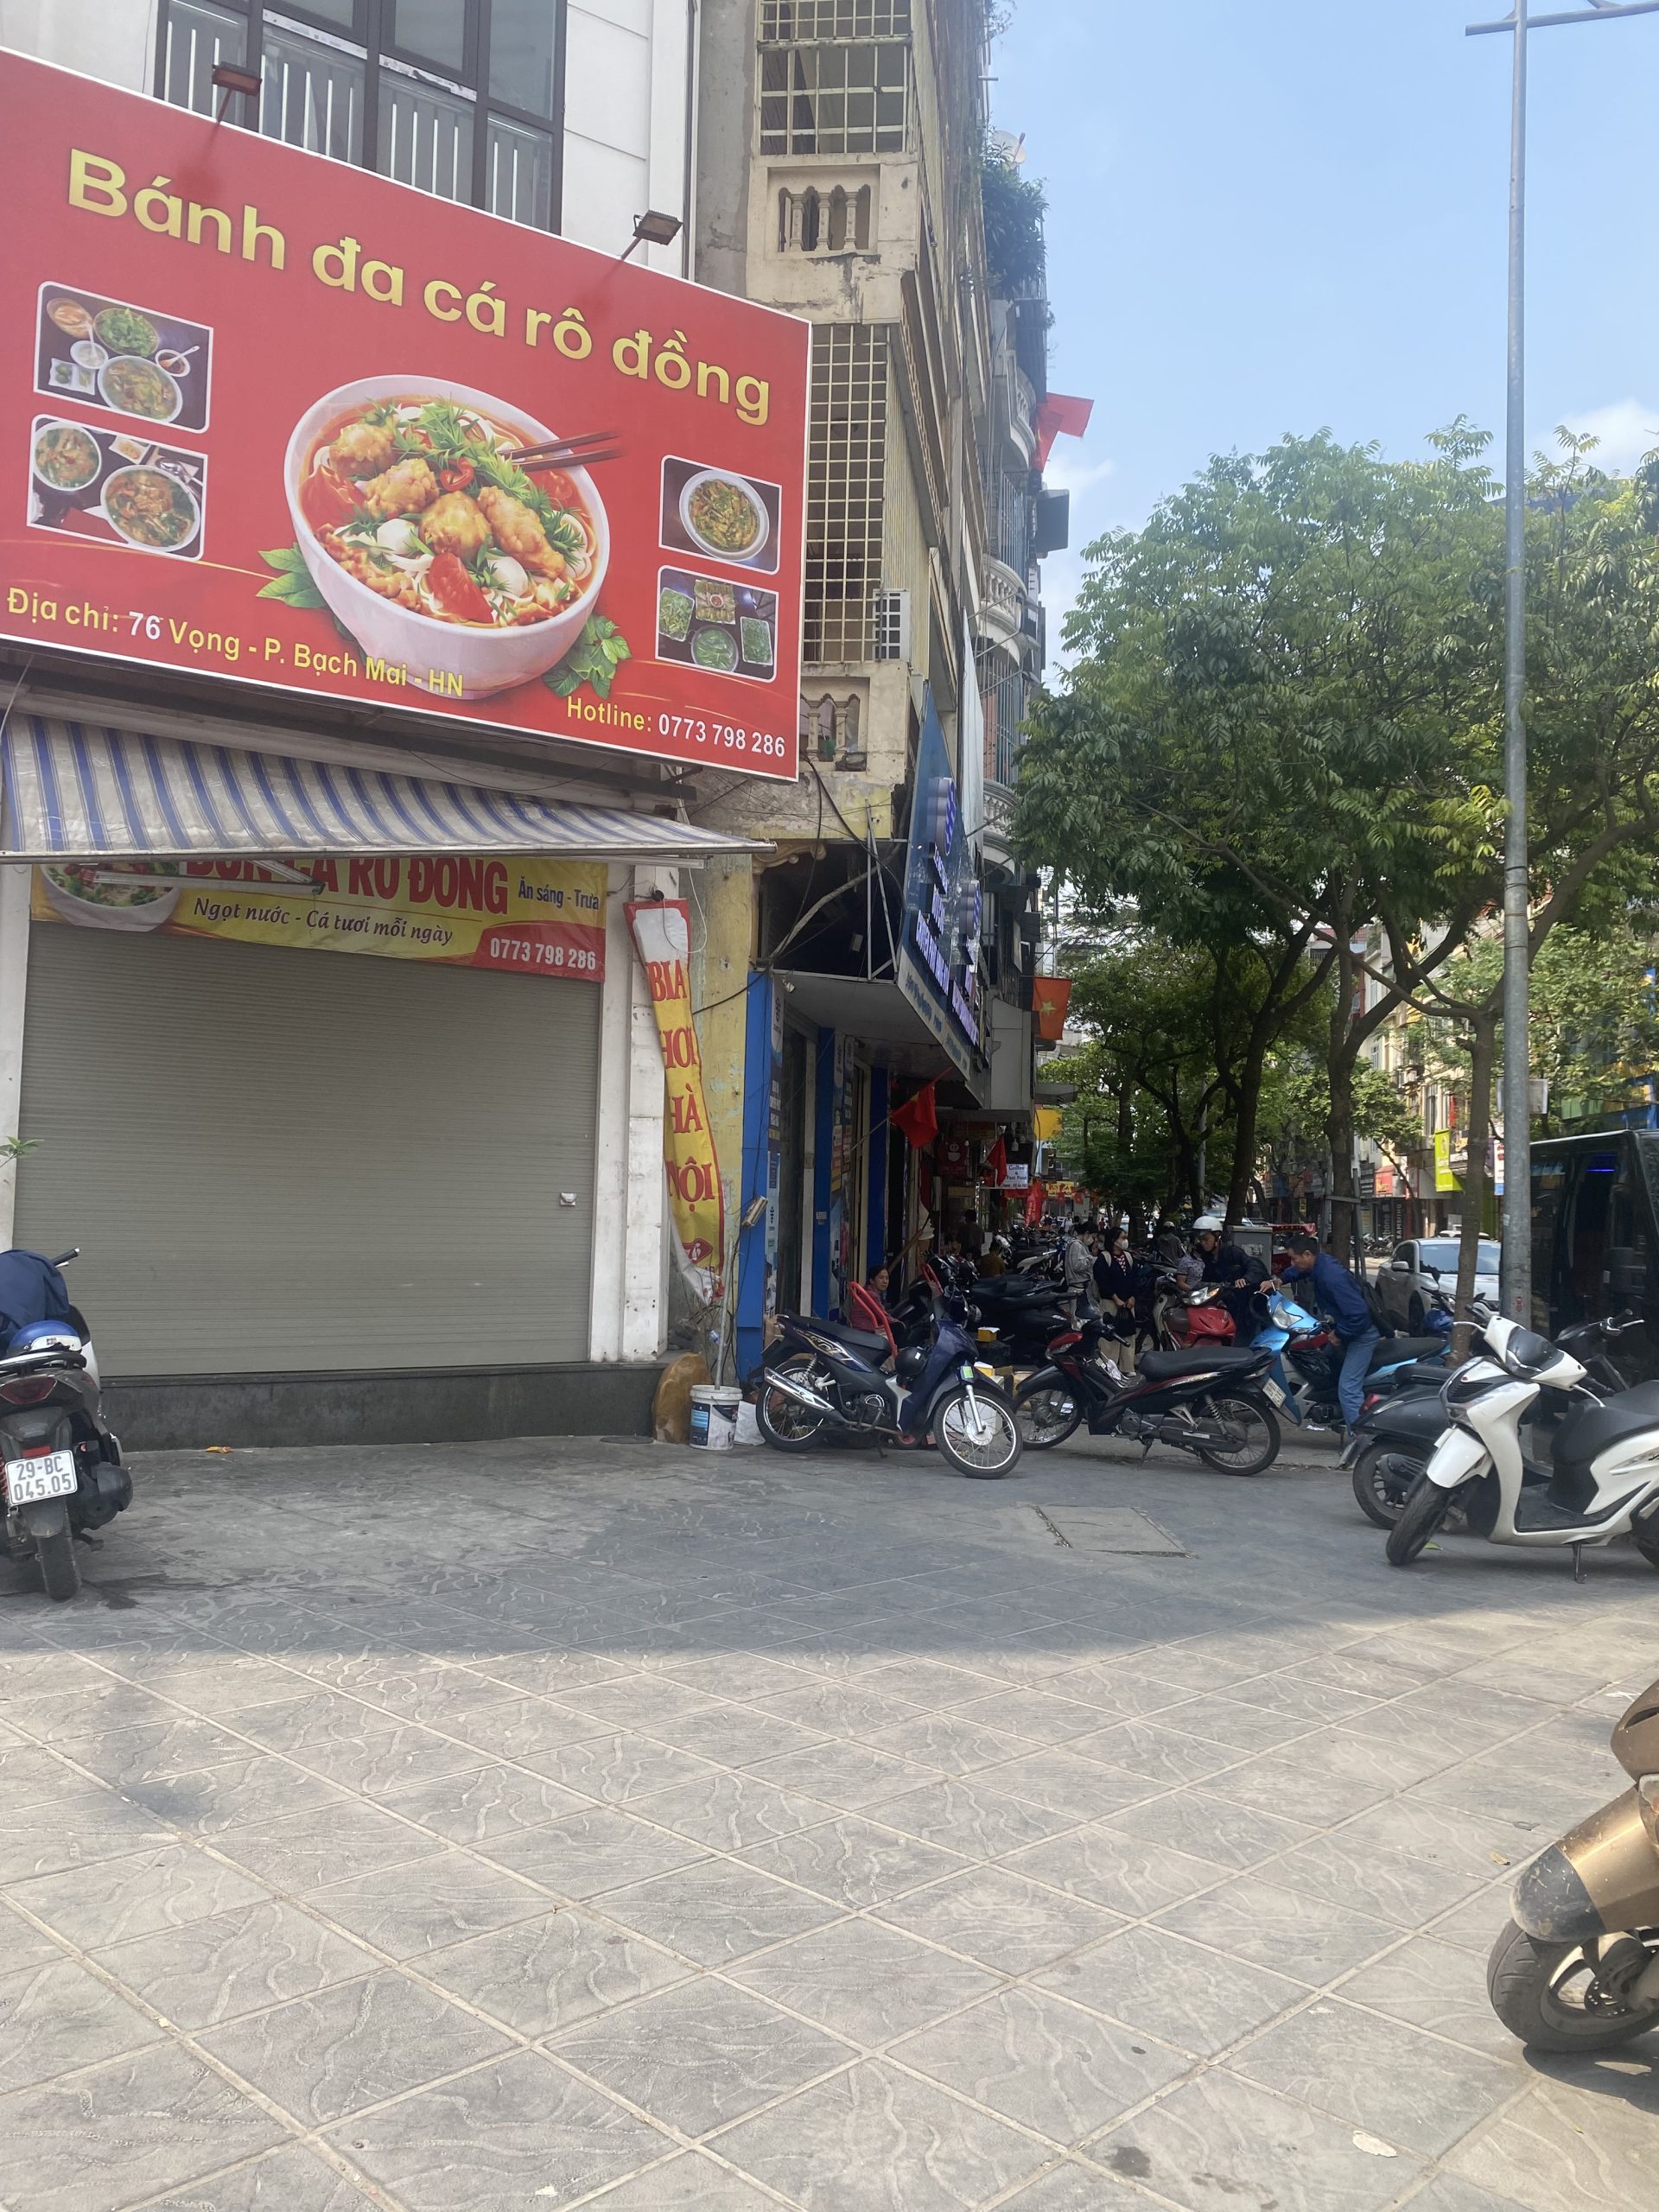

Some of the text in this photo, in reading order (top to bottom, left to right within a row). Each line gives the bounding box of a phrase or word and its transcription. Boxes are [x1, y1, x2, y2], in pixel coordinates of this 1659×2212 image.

[67, 148, 771, 427] Bánh đa cá rô đồng
[7, 587, 57, 624] Địa
[65, 601, 118, 632] chỉ:
[129, 611, 162, 640] 76
[168, 618, 240, 661] Vọng
[264, 637, 285, 664] P.
[294, 642, 358, 677] Bạch
[365, 655, 408, 687] Mai
[428, 668, 464, 697] HN
[567, 695, 785, 758] Hotline: 0773 798 286
[518, 876, 534, 899] Ăn
[537, 883, 564, 909] sáng
[574, 888, 601, 911] Trưa
[193, 896, 241, 922] Ngọt
[245, 902, 291, 924] nước
[306, 909, 330, 930] Cá
[334, 915, 371, 933] tươi
[373, 914, 408, 938] mỗi
[410, 921, 454, 946] ngày
[489, 937, 596, 970] 0773 798 286
[646, 959, 688, 1002] BIA
[13, 1473, 72, 1502] 045.05
[16, 1456, 64, 1481] 29-BC
